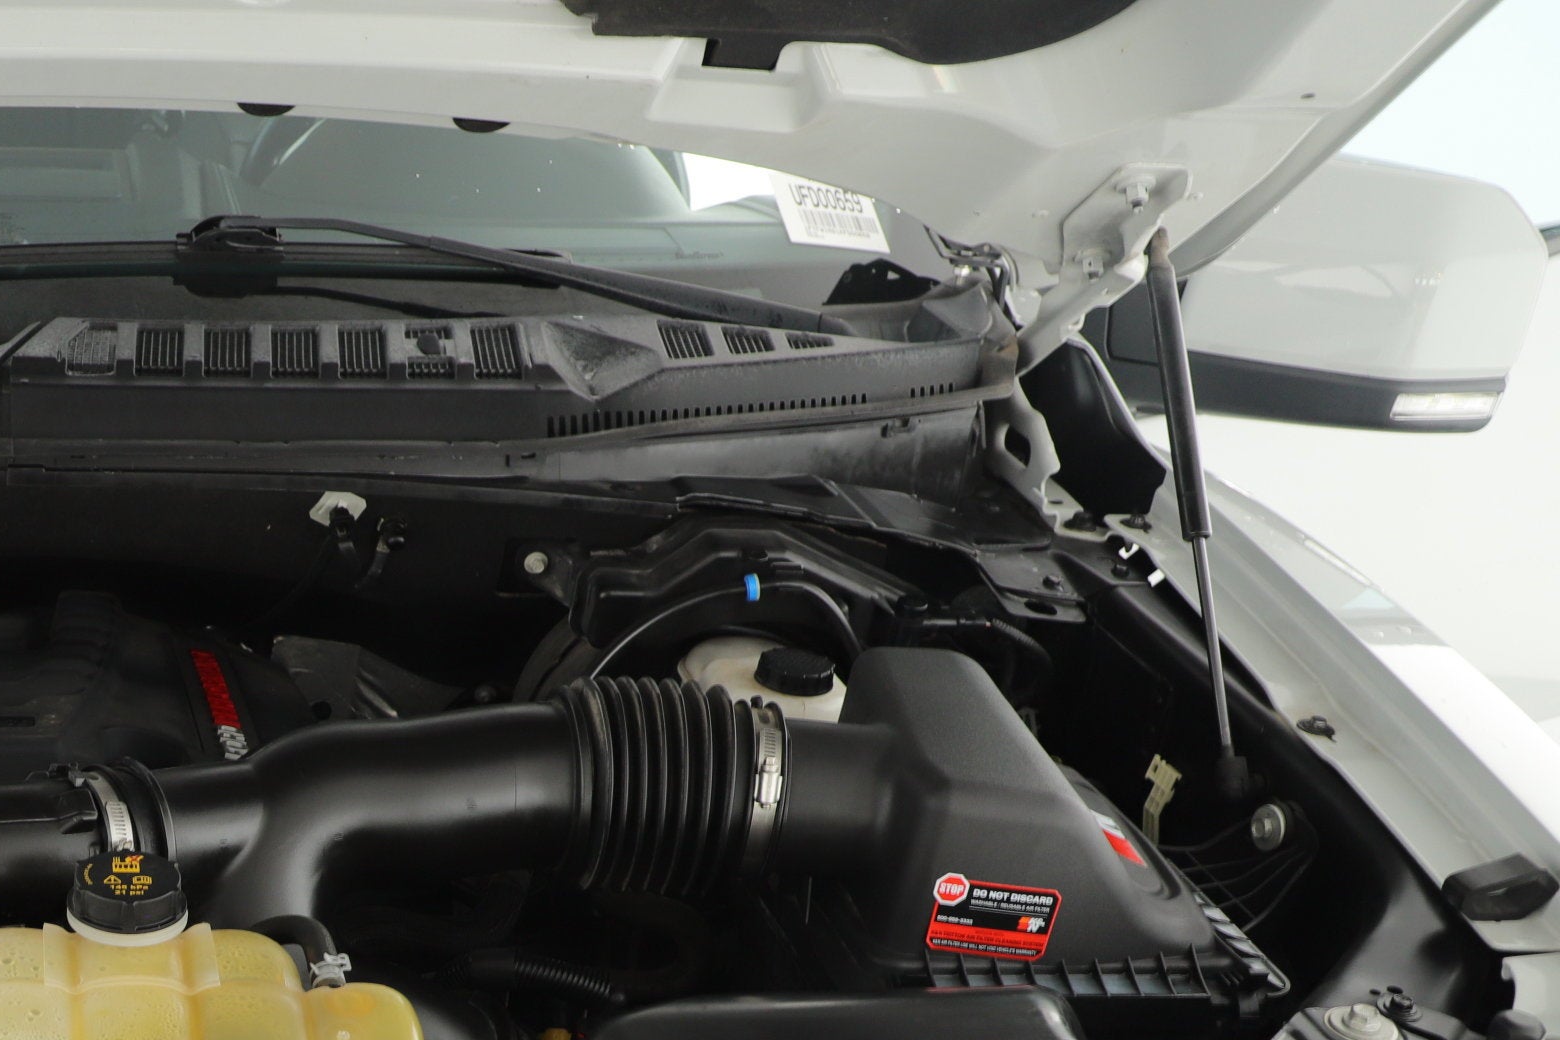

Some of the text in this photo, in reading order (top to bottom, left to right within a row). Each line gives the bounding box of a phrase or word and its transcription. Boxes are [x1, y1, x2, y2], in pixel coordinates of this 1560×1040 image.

[939, 882, 964, 895] STOP
[973, 888, 1053, 906] DO NOT DISCARD
